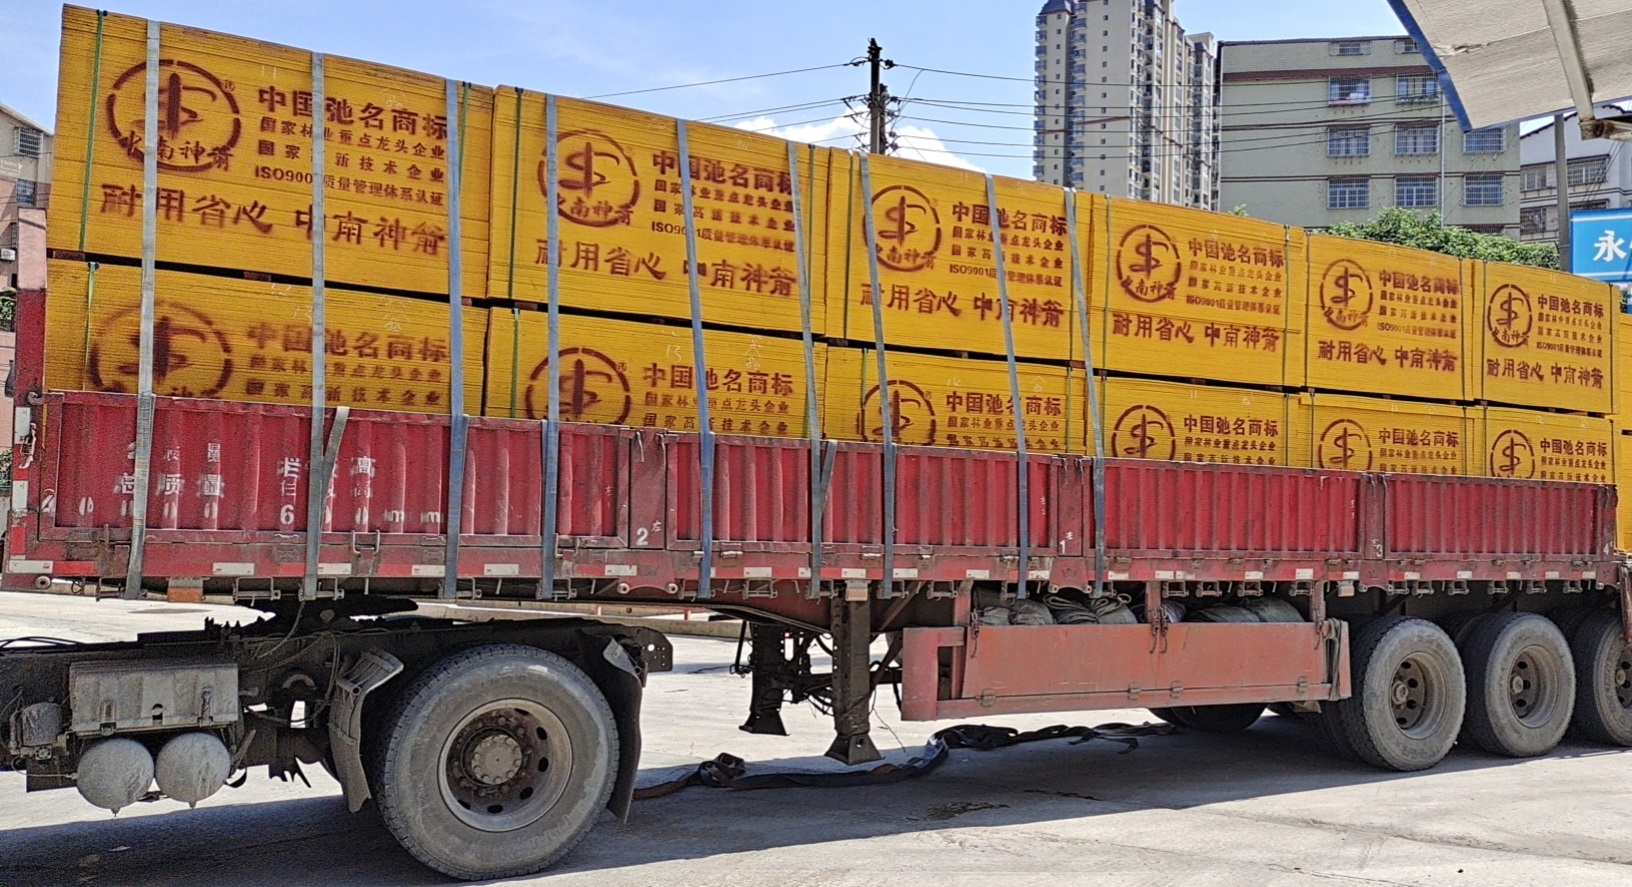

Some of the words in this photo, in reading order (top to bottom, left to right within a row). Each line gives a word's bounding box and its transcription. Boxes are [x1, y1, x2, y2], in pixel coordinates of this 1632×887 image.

[258, 139, 444, 183] 国家新技术企业
[255, 165, 444, 206] ISO900质量管理体系认证
[101, 183, 273, 234] 耐用省心
[651, 221, 795, 252] ISO901质量管理体系认证
[1592, 230, 1632, 262] 永
[949, 264, 1062, 287] ISO9001质管理体系认证
[1112, 312, 1195, 344] 耐用省心
[250, 354, 441, 381] 国家林重点龙头企业
[1318, 340, 1387, 366] 耐用省心
[1486, 358, 1544, 381] 耐用省心
[636, 527, 648, 546] 2
[1059, 540, 1066, 554] 1
